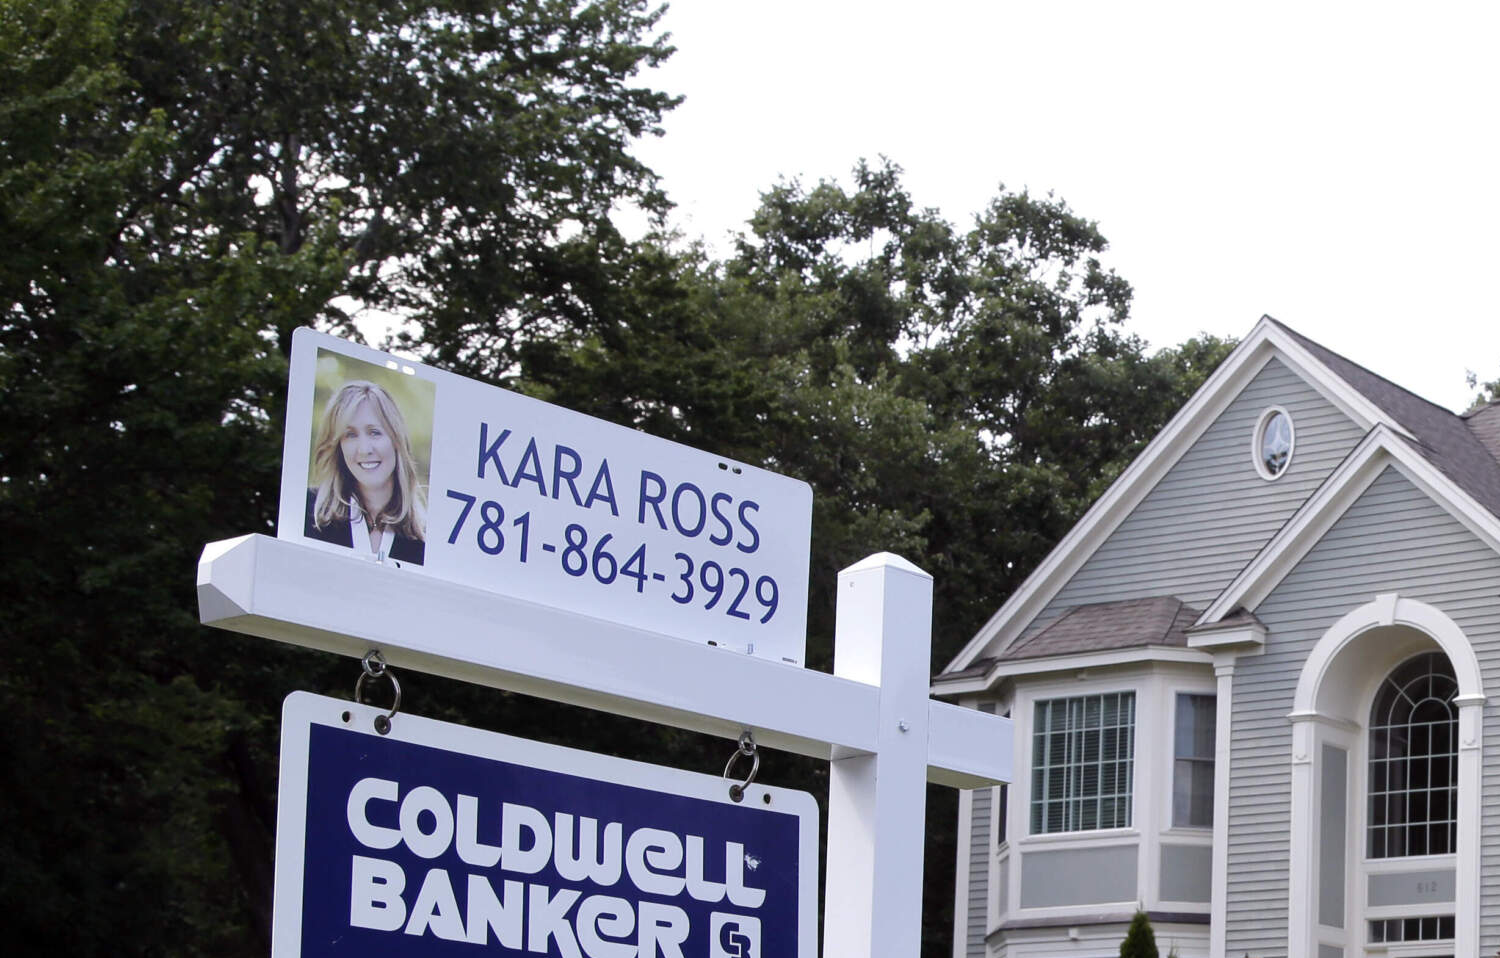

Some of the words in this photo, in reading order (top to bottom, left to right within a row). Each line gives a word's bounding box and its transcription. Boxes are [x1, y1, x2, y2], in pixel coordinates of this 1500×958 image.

[477, 421, 620, 518] KARA
[637, 469, 761, 554] ROSS
[446, 489, 780, 626] 781-864-3929
[346, 777, 767, 909] COLDWELL
